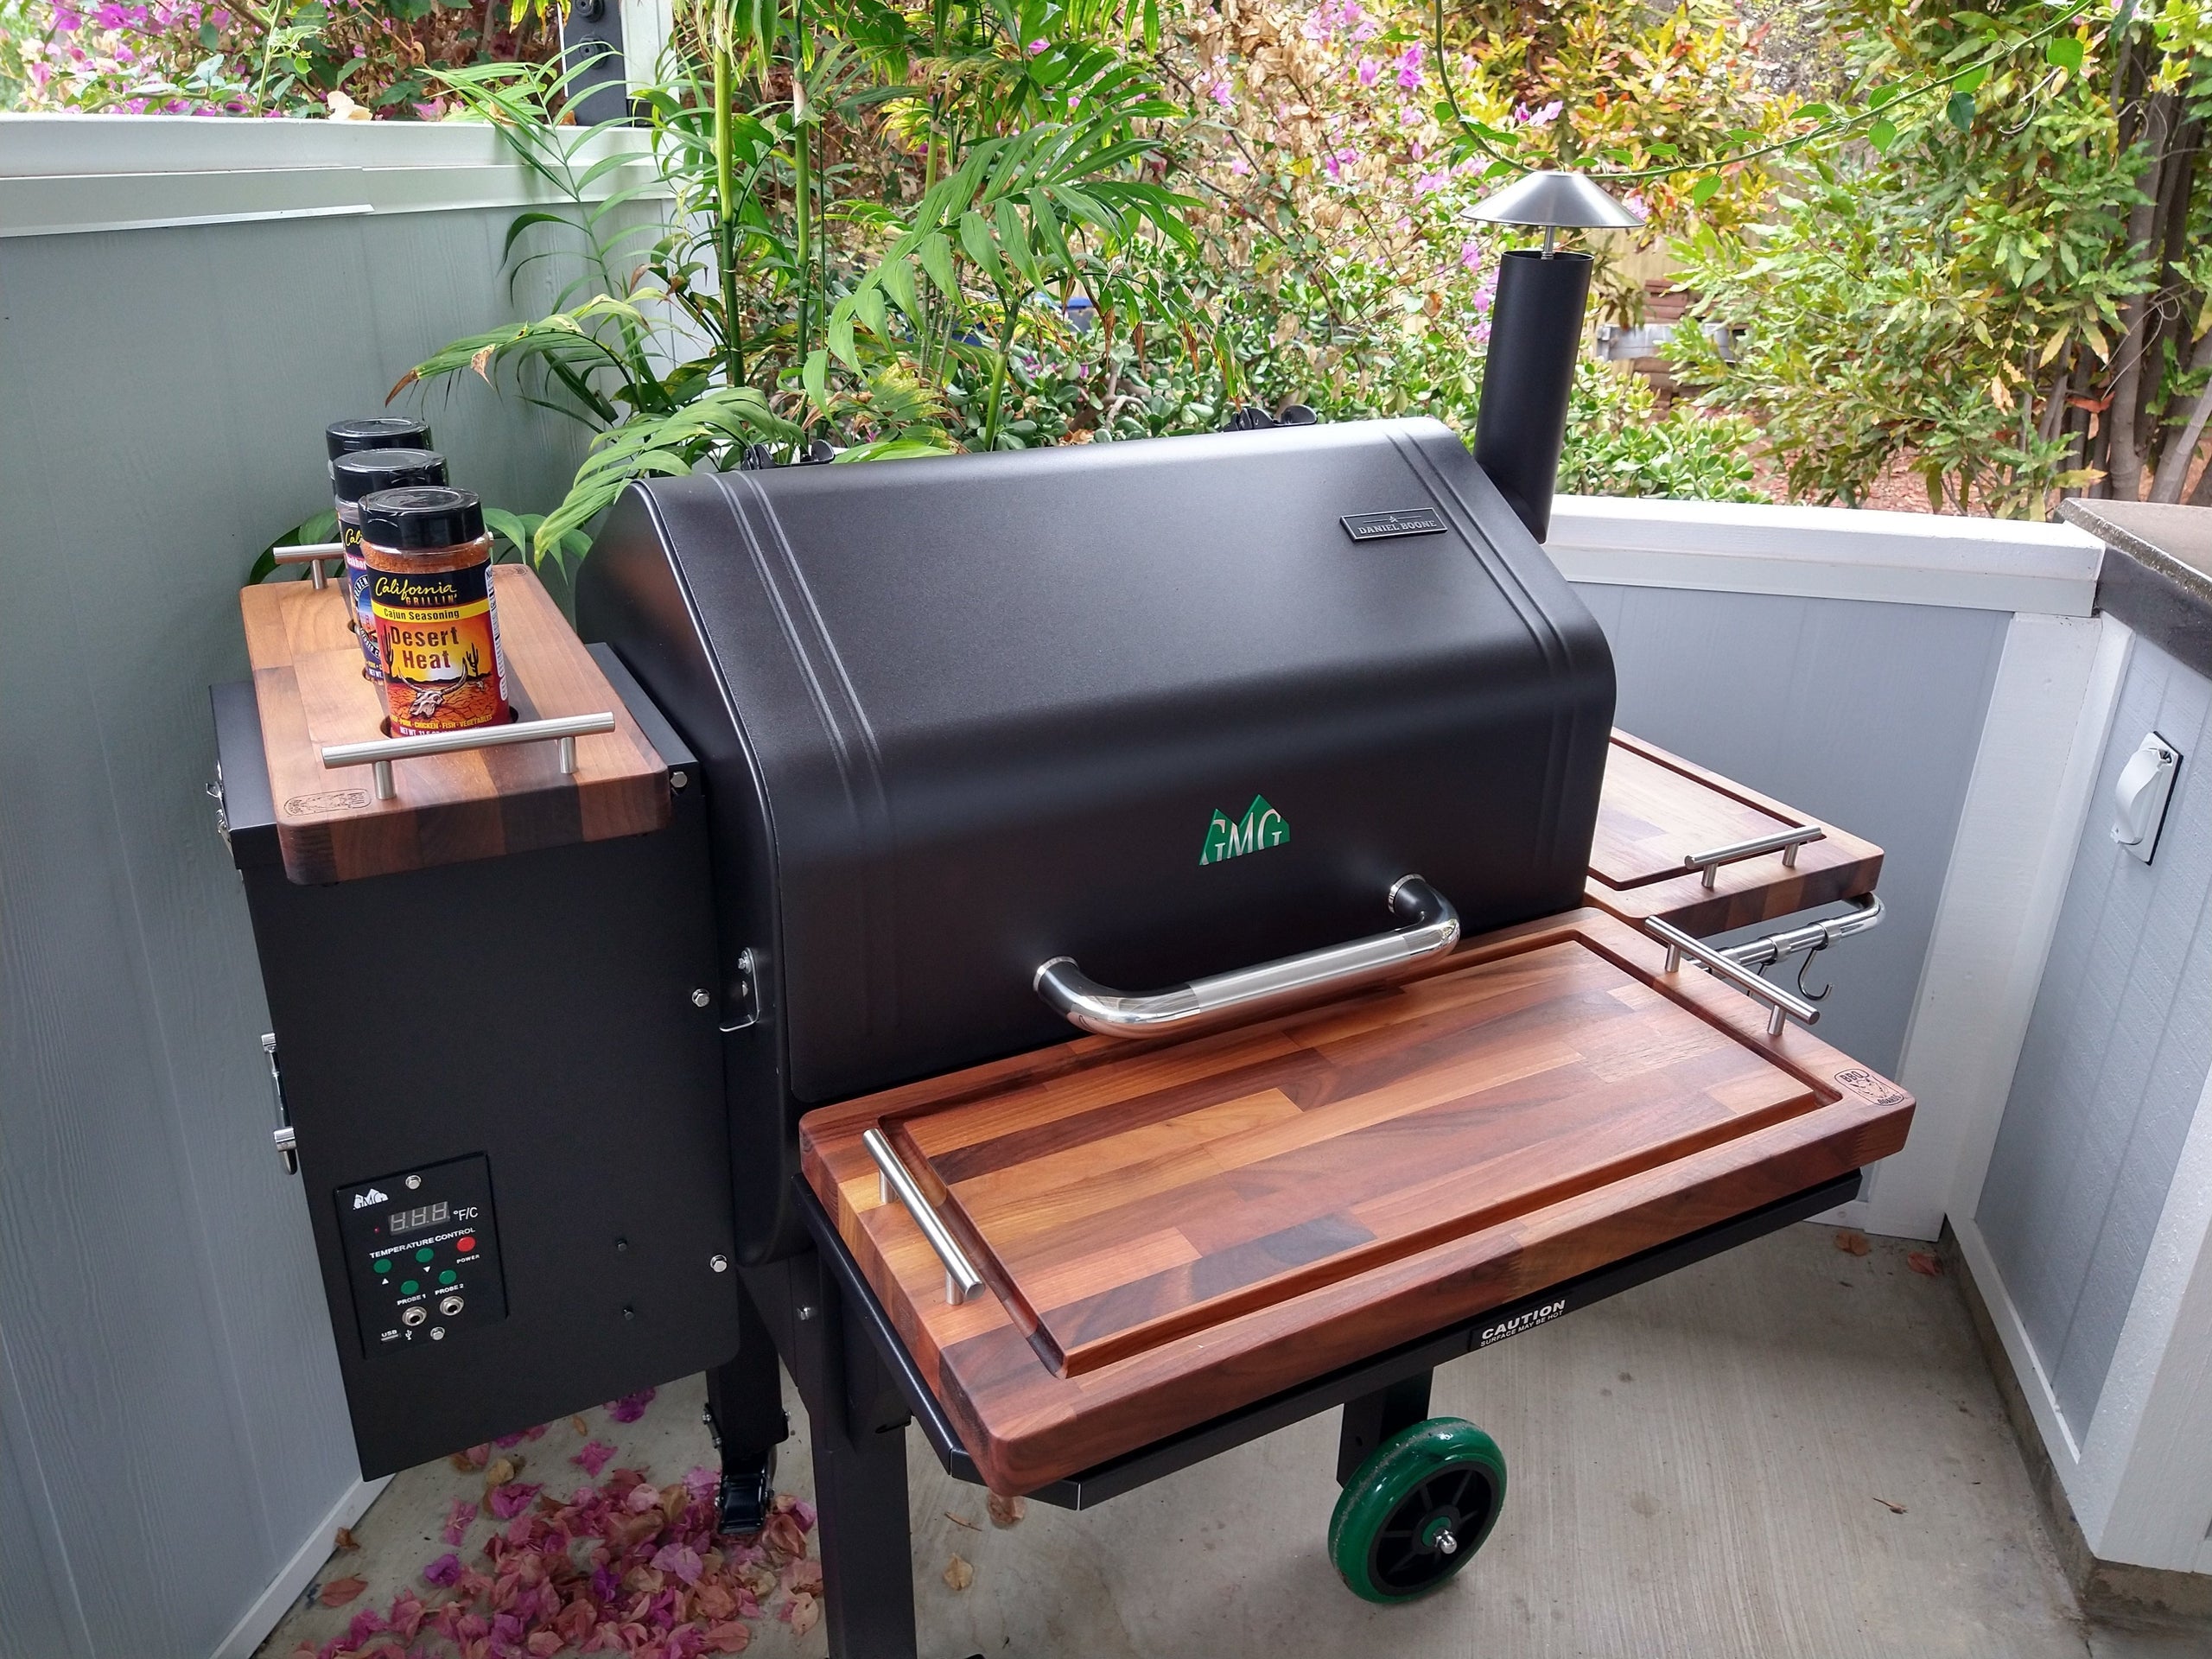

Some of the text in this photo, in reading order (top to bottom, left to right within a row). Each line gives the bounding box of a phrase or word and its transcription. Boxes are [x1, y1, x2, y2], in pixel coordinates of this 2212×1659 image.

[1357, 520, 1438, 534] DANIEL BOONE
[375, 576, 457, 601] California
[384, 608, 460, 620] Cajun Seasoning
[390, 626, 459, 646] Desert
[402, 650, 451, 669] Heat
[460, 714, 493, 728] VEGETABLES
[1200, 803, 1287, 865] GMG
[370, 1227, 475, 1258] TEMPERATURE CONTROL
[456, 1254, 480, 1264] POWER
[435, 1286, 459, 1295] PROBE
[397, 1295, 421, 1306] PROBE
[1482, 1300, 1566, 1339] CAUTION
[381, 1329, 397, 1338] USB
[1480, 1310, 1564, 1347] SURFACE MAY BE HOT
